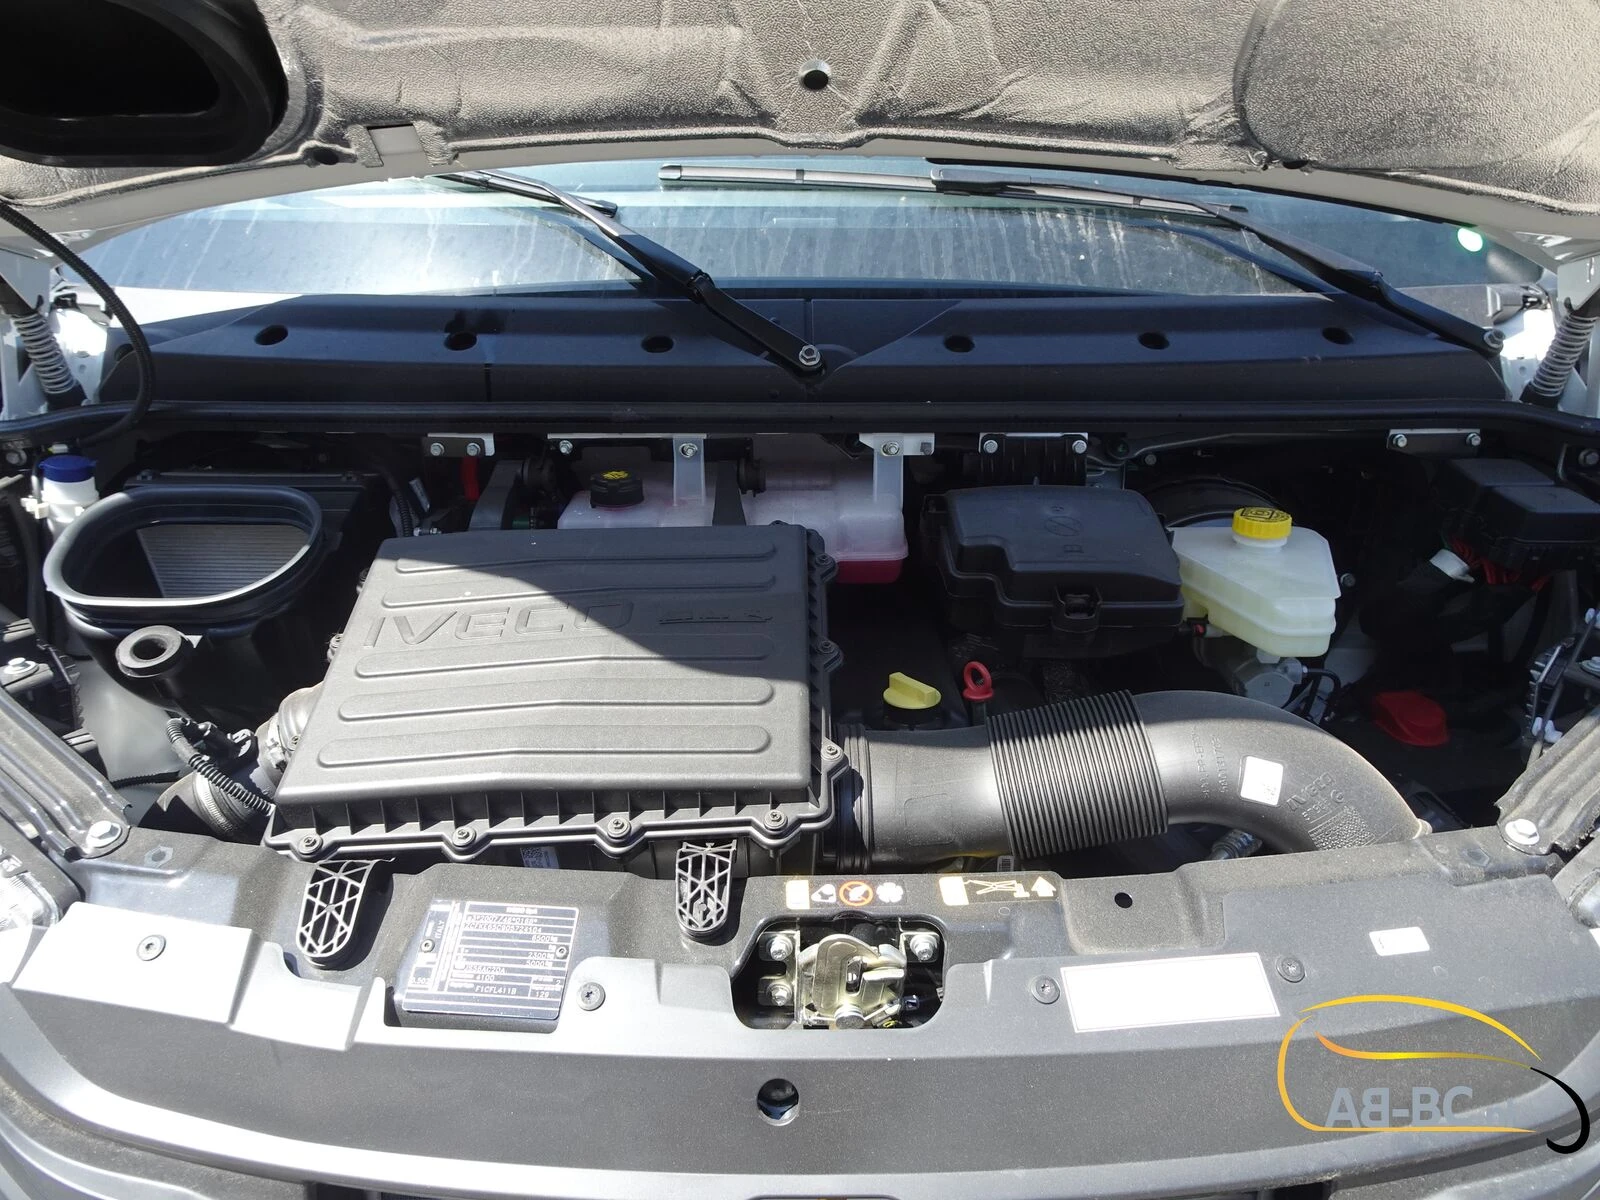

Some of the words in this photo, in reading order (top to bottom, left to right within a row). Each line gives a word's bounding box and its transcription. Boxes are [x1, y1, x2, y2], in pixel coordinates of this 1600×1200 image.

[363, 600, 634, 648] IVECO
[435, 920, 445, 939] ITALY
[476, 974, 495, 982] 4100
